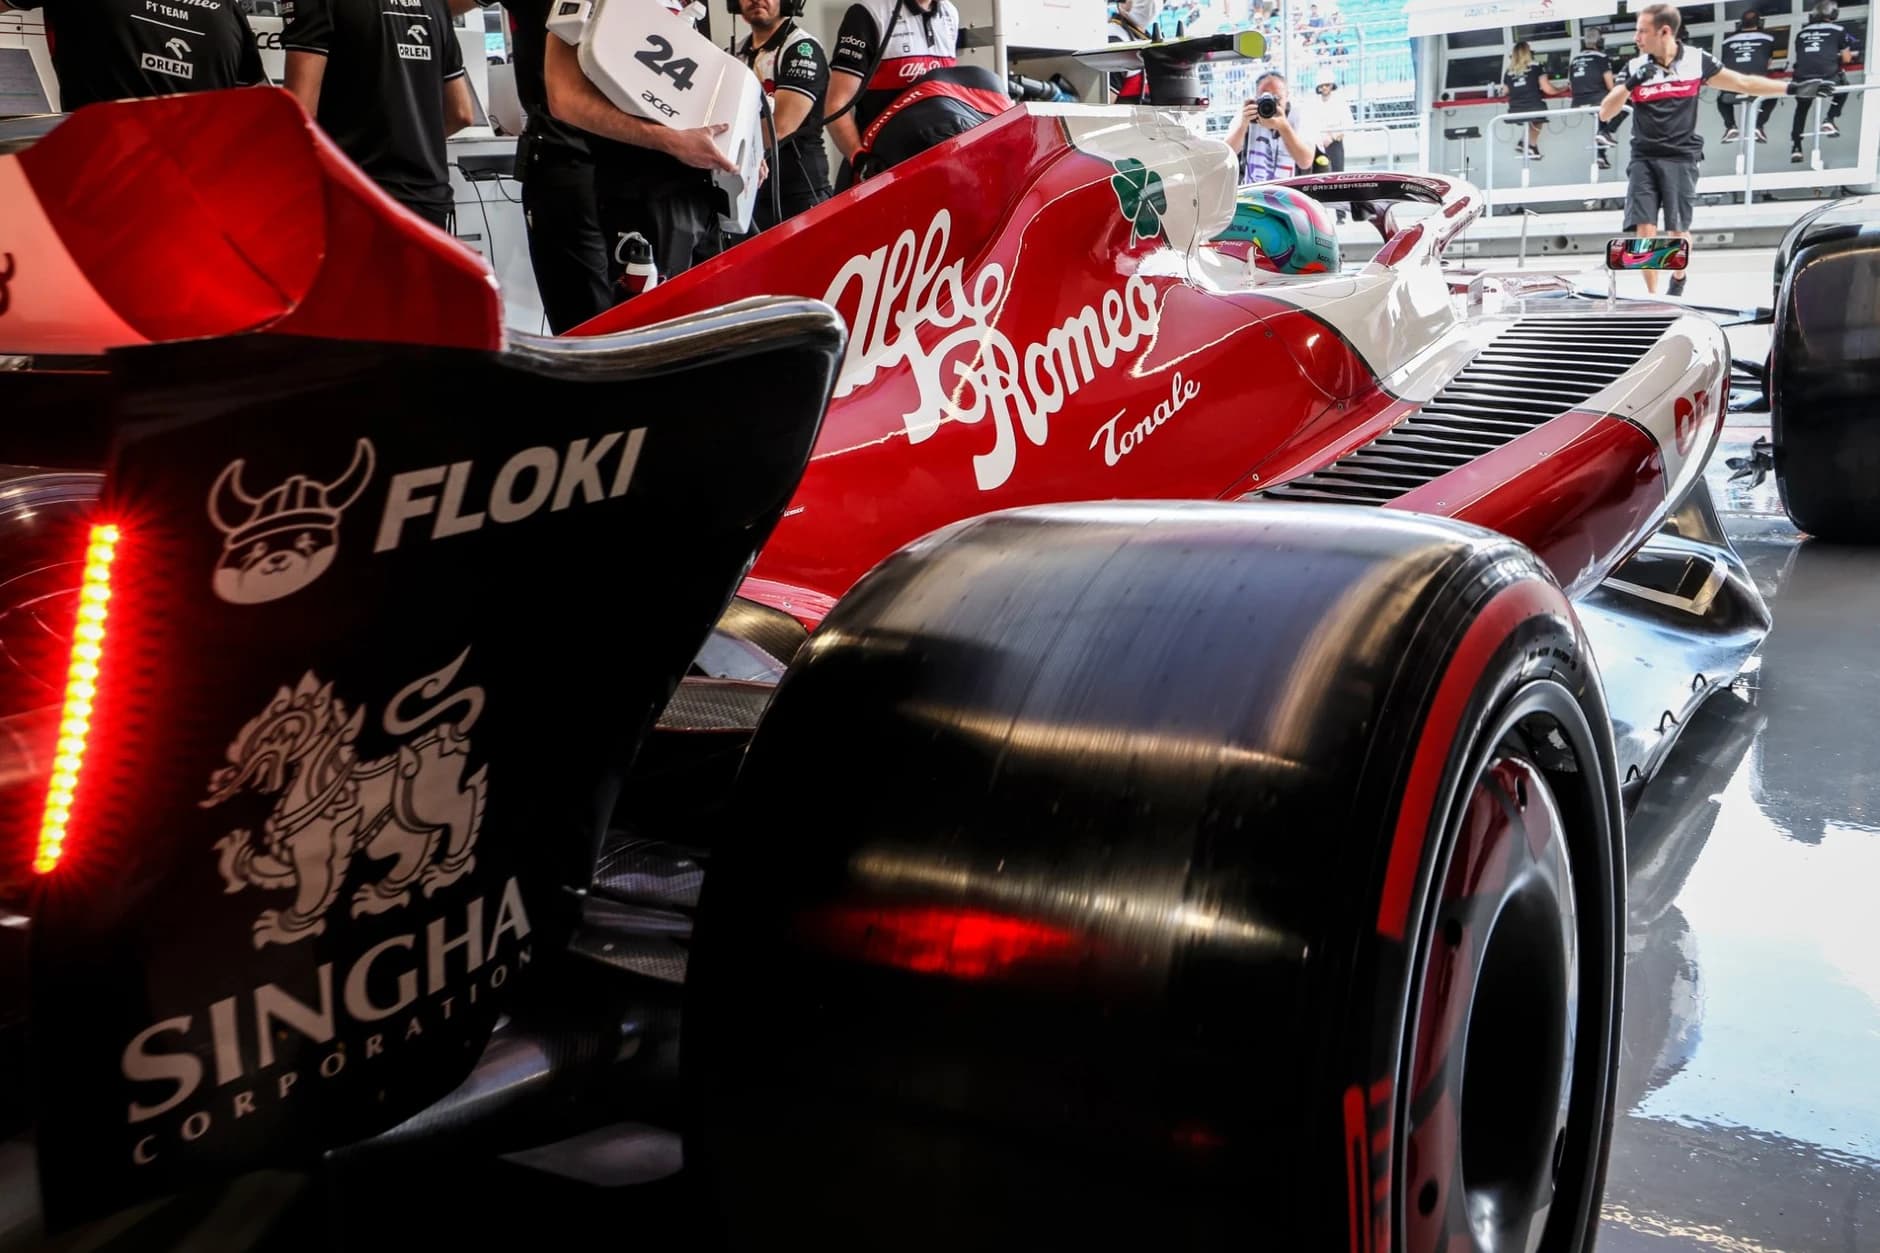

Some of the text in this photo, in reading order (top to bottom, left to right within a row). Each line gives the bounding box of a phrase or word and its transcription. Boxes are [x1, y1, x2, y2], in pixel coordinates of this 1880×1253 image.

[145, 1, 189, 21] F1 TEAM
[400, 47, 430, 58] ORLEN
[144, 56, 190, 77] ORLEN
[633, 34, 699, 92] 24
[641, 89, 681, 118] acer
[823, 208, 1006, 444] Alfa
[937, 275, 1158, 491] Romeo
[1089, 371, 1201, 467] Tonale
[373, 426, 648, 554] FLOKI
[121, 876, 532, 1124] SINGHA
[132, 944, 533, 1166] CORPORATION
